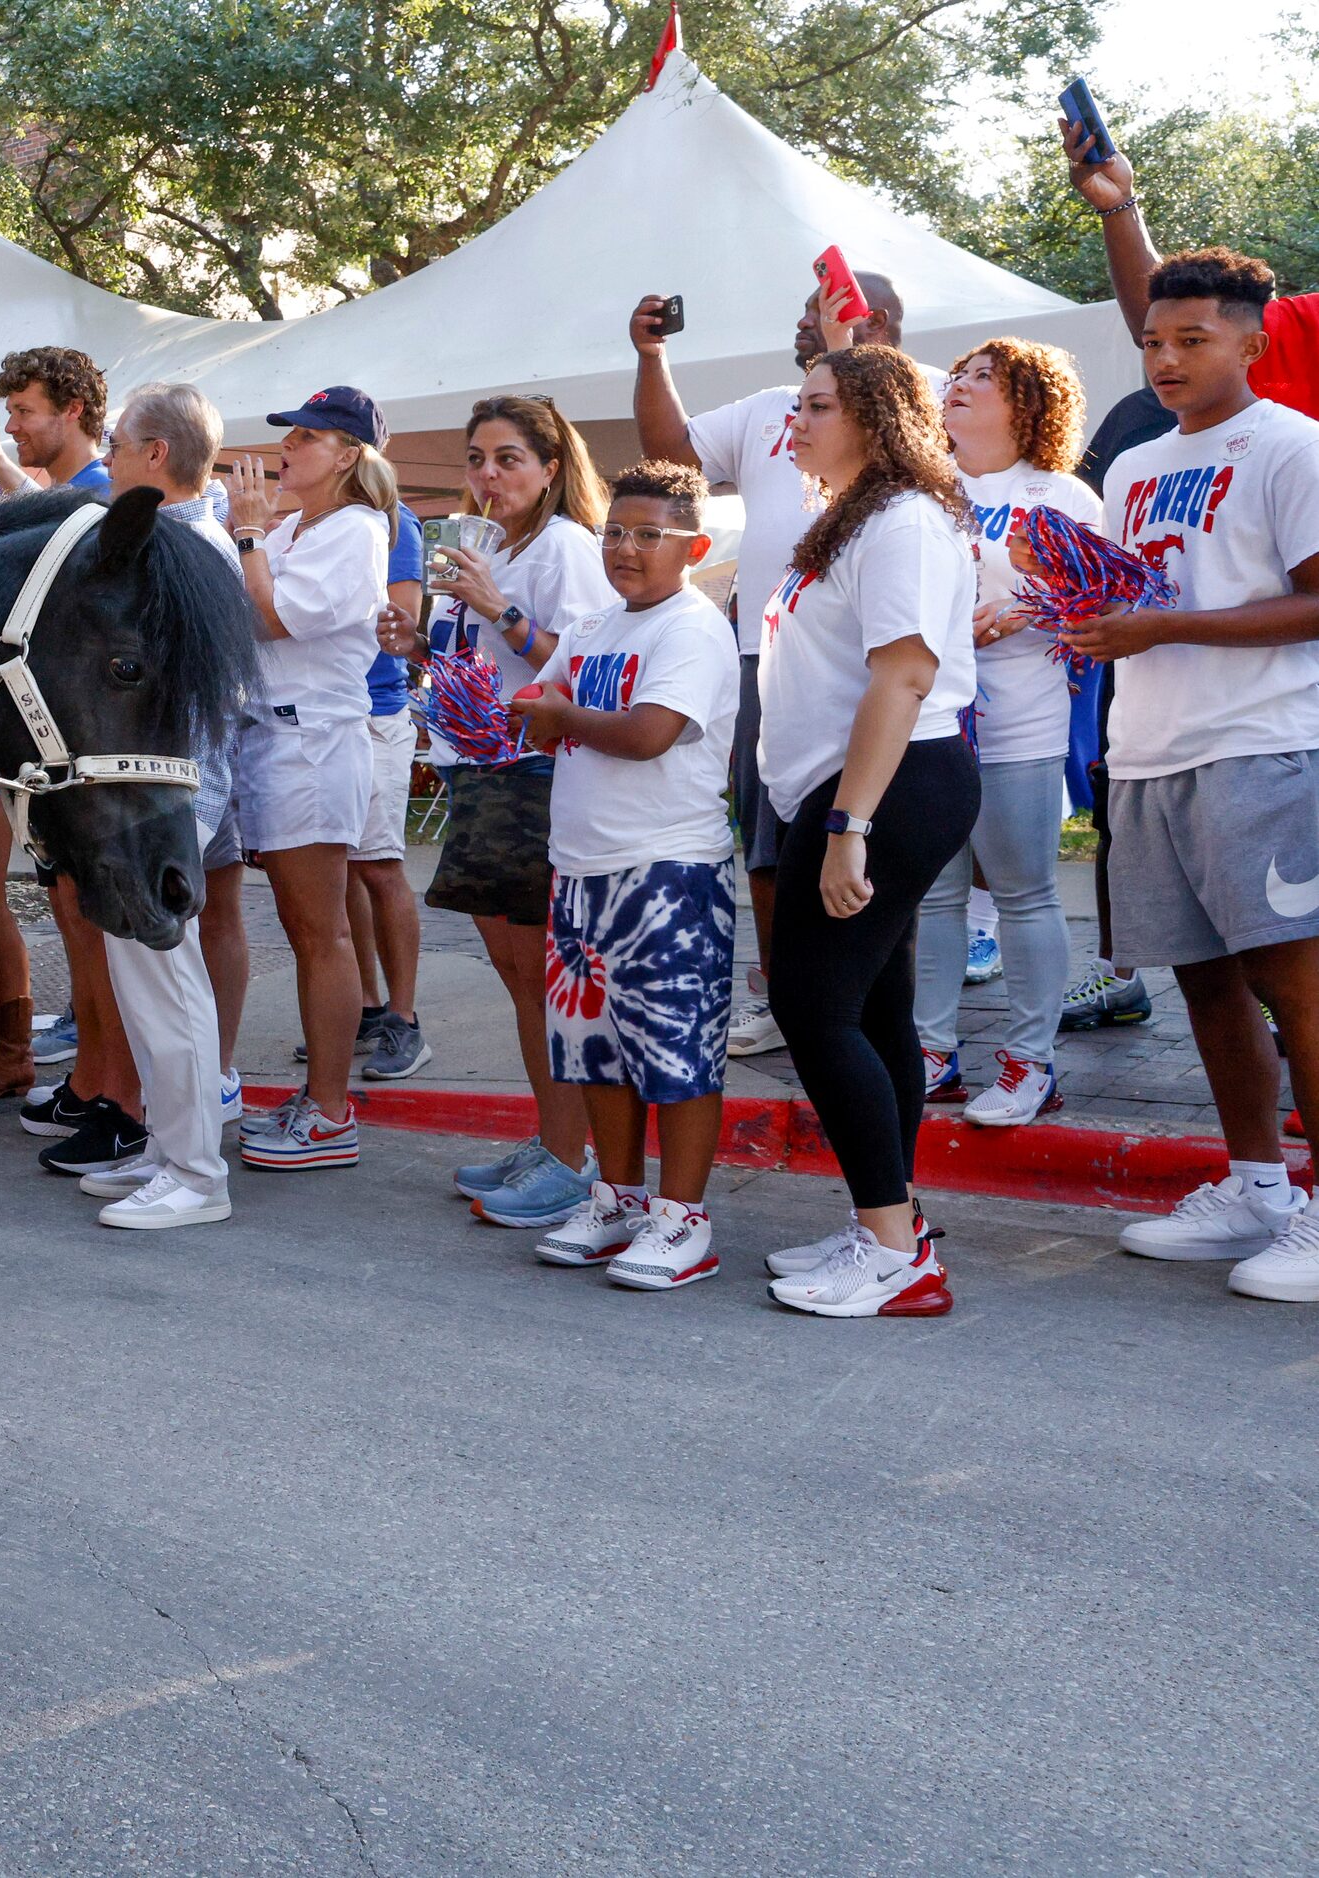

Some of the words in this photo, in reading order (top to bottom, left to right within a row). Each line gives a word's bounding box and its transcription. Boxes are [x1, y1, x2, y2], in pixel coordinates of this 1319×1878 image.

[1226, 435, 1252, 448] BEAT
[1227, 443, 1249, 453] TCU
[1122, 465, 1234, 547] TCWHO?
[20, 693, 49, 738] SMU
